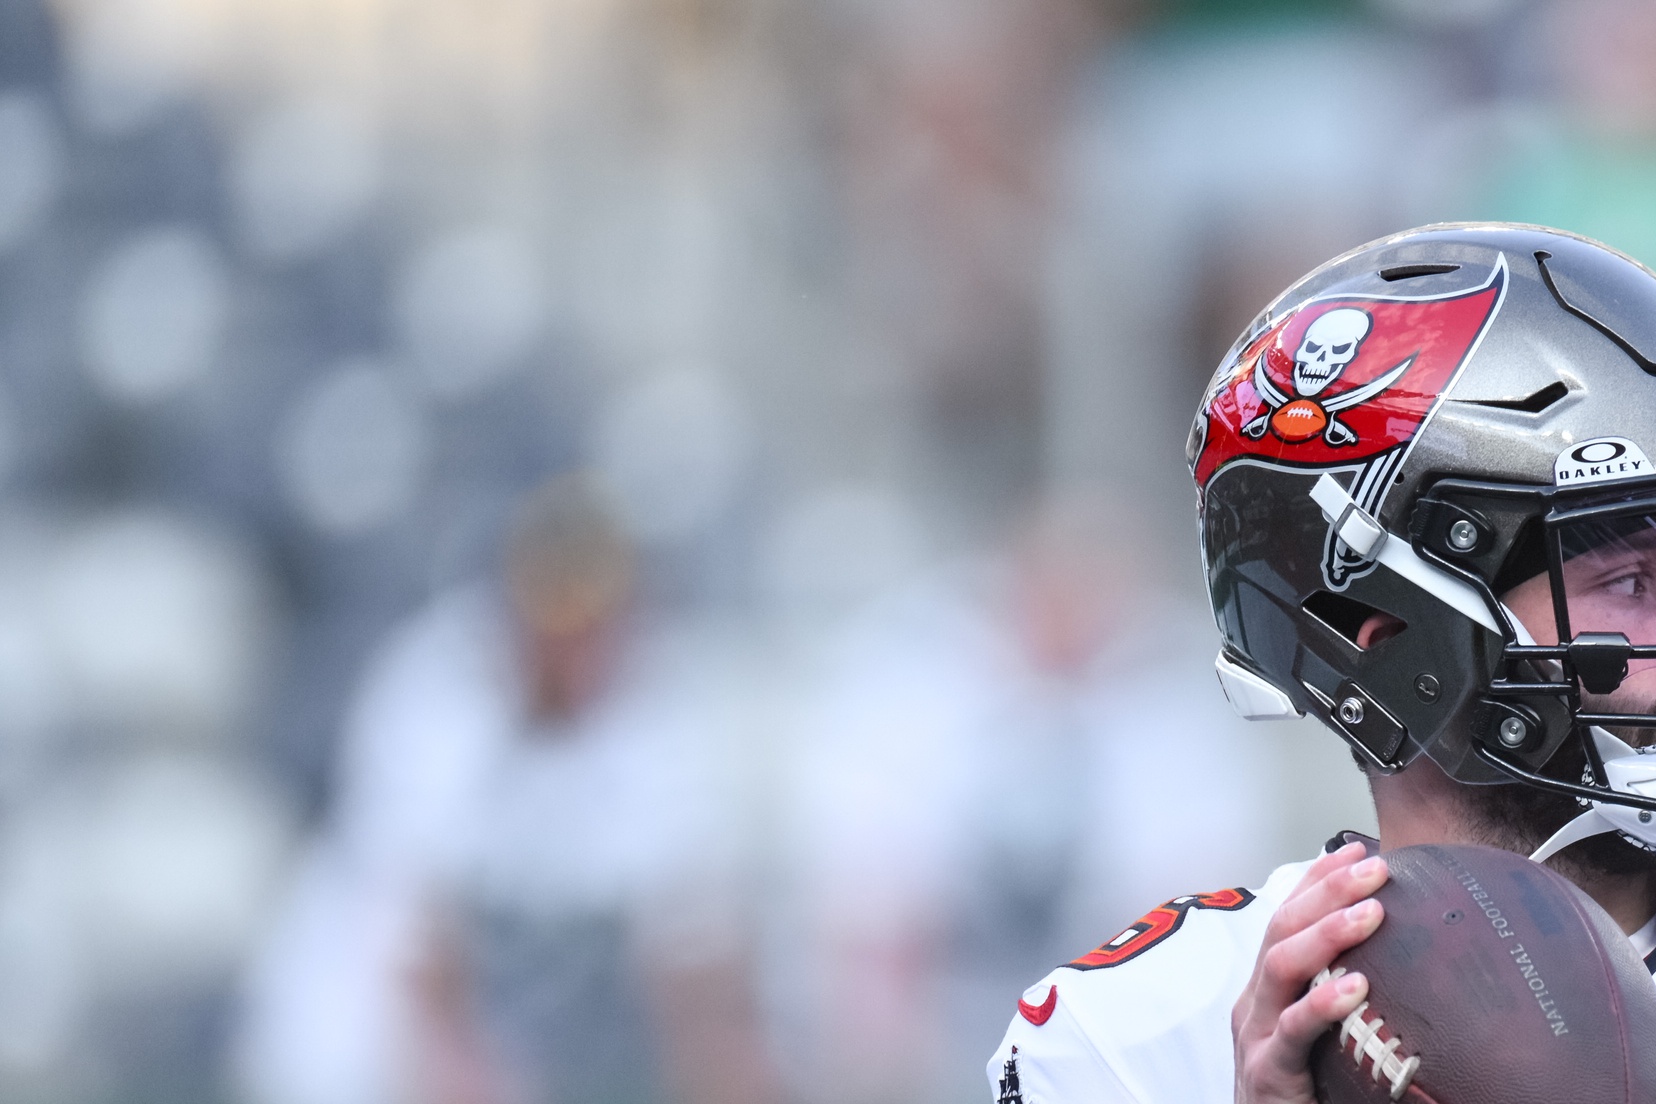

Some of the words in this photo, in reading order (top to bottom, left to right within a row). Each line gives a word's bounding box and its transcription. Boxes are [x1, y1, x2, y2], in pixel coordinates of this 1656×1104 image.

[1559, 460, 1641, 480] OAKLEY
[1457, 872, 1515, 939] FOOTBALL
[1510, 943, 1570, 1038] NATIONAL
